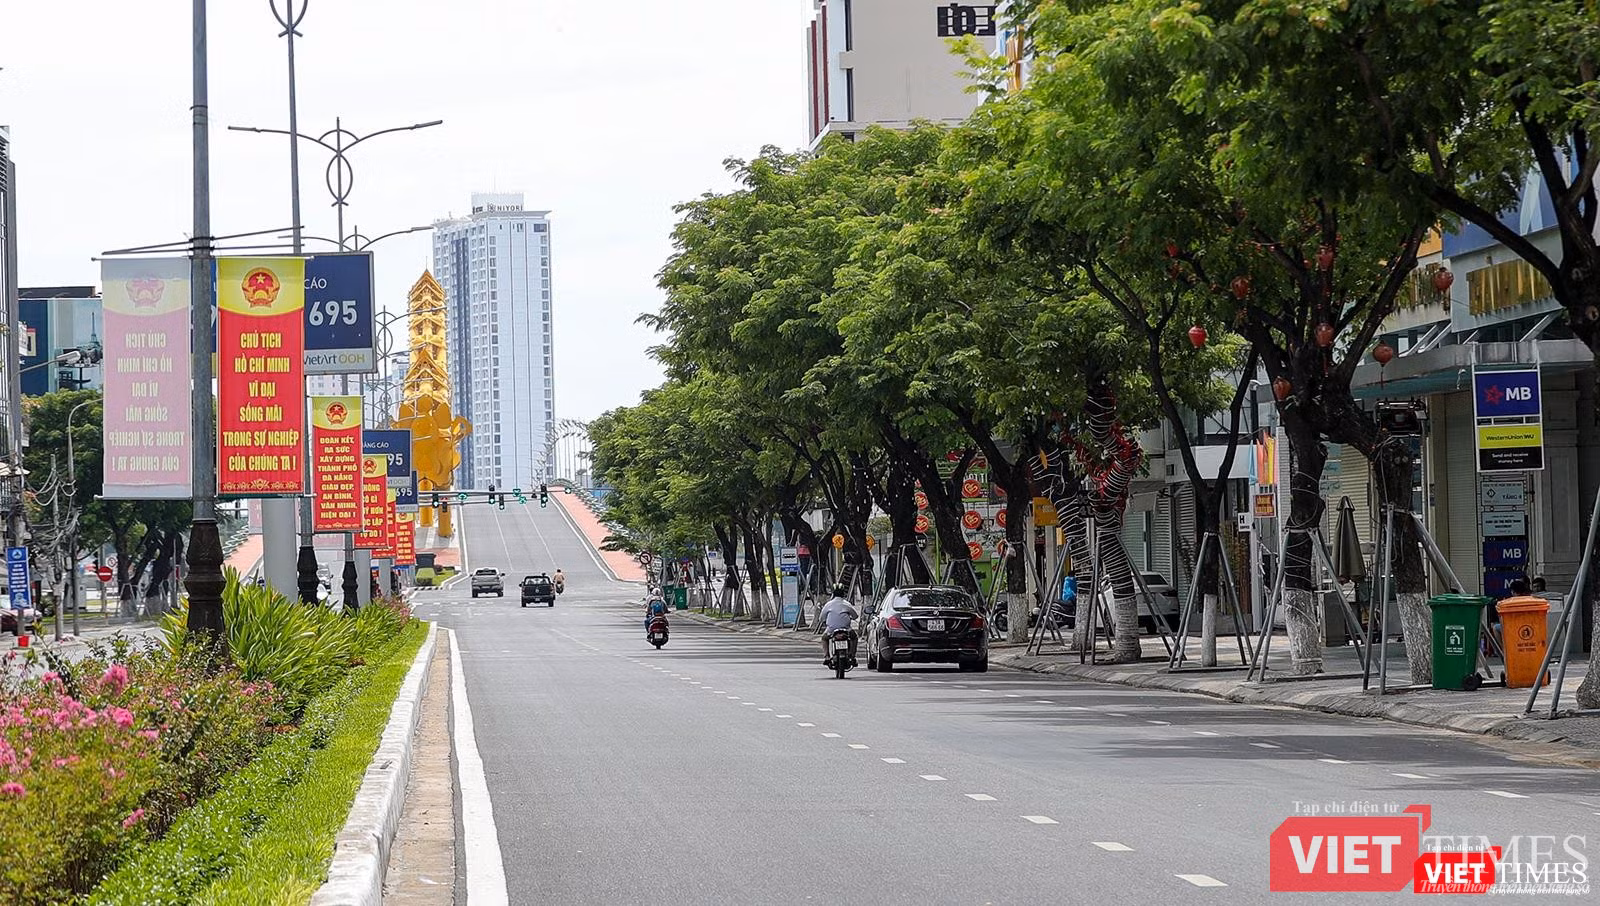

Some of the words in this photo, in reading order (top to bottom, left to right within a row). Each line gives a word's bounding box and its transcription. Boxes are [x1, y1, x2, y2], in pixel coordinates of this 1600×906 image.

[304, 276, 327, 289] CÁO
[309, 300, 358, 326] 695
[240, 330, 259, 348] CHỦ
[261, 332, 282, 351] TỊCH
[234, 353, 247, 373] HỒ
[249, 355, 265, 373] CHÍ
[266, 357, 290, 373] MINH
[339, 353, 365, 364] OOH
[260, 381, 276, 400] ĐẠI
[1505, 387, 1532, 401] MB
[239, 402, 264, 422] SỐNG
[223, 431, 252, 447] TRONG
[254, 429, 267, 448] SỰ
[268, 428, 299, 449] NGHIỆP
[228, 452, 247, 471] CỦA
[248, 453, 279, 471] CHÚNG
[280, 455, 291, 471] TA
[363, 483, 381, 492] HÔNG
[1502, 548, 1522, 559] MB
